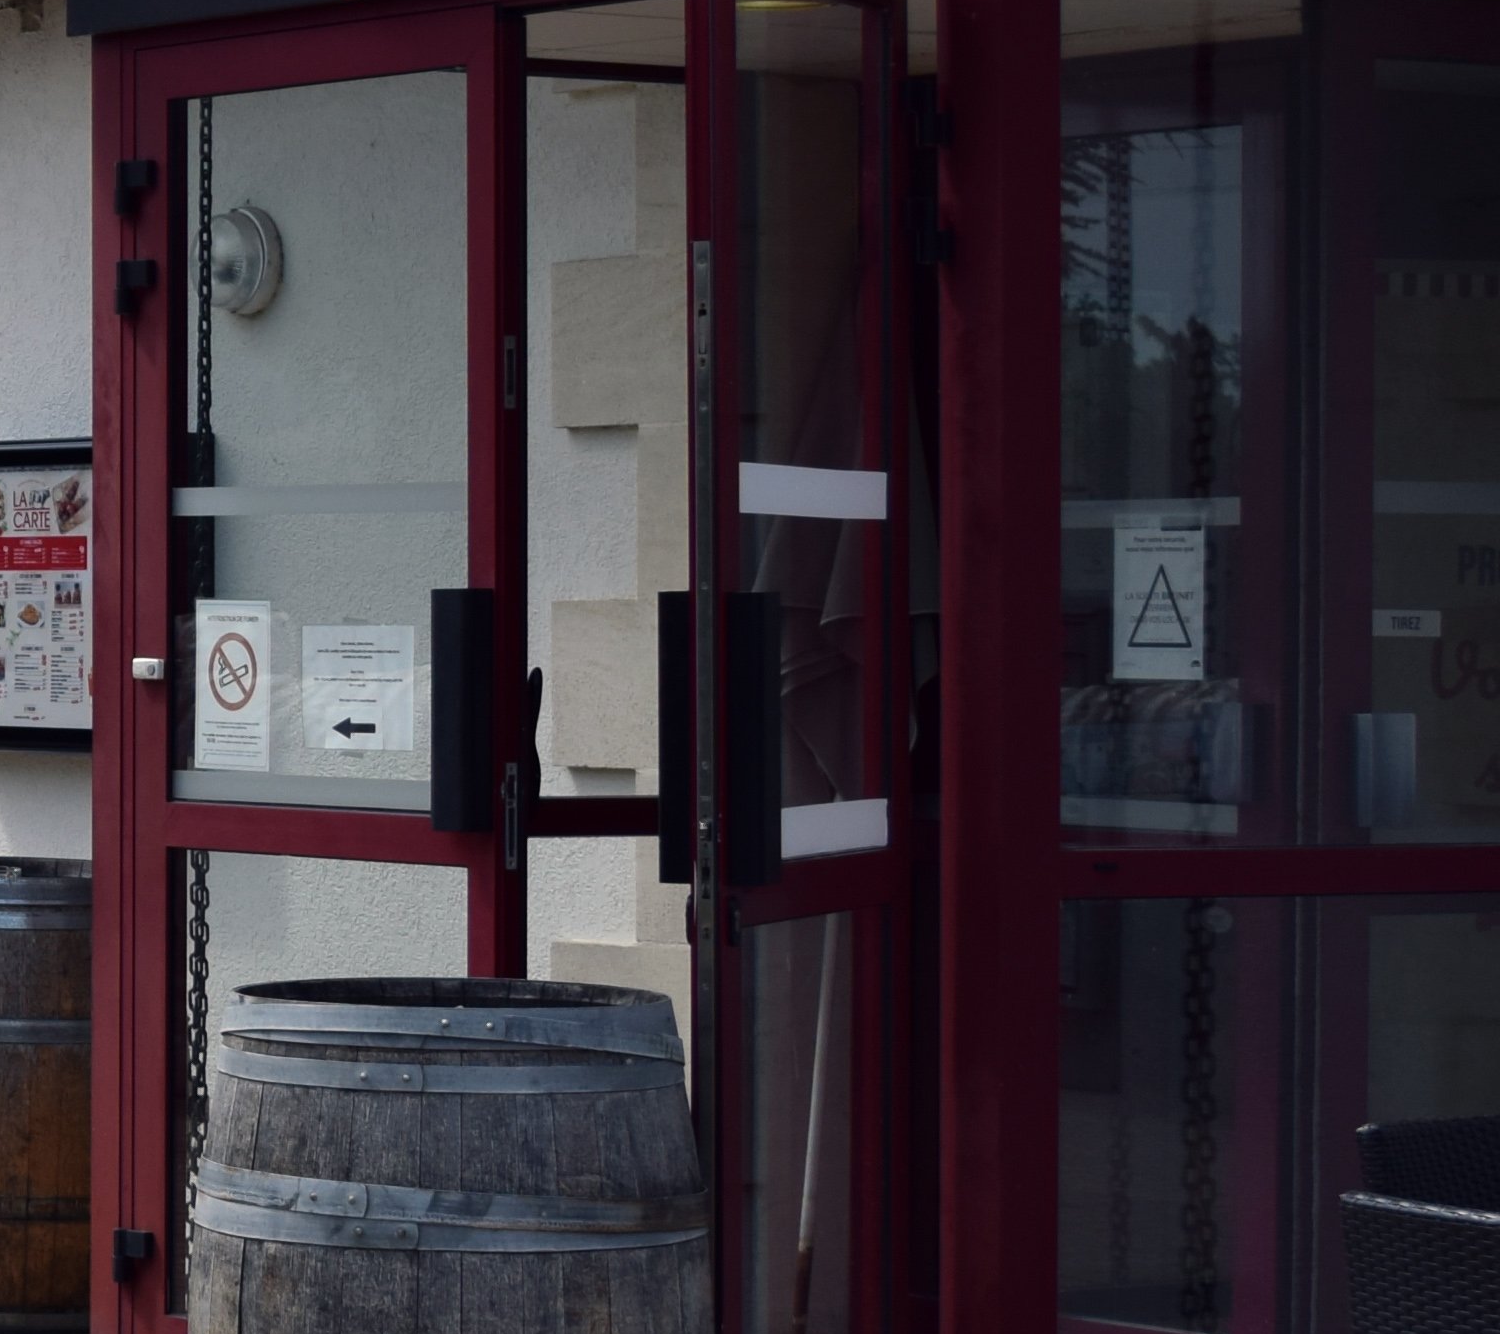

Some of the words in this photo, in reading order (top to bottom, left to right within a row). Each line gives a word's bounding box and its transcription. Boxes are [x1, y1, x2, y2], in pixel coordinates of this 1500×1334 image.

[13, 490, 27, 507] LA
[13, 511, 51, 529] CARTE
[1458, 545, 1500, 586] PR
[1391, 616, 1421, 631] TIREZ
